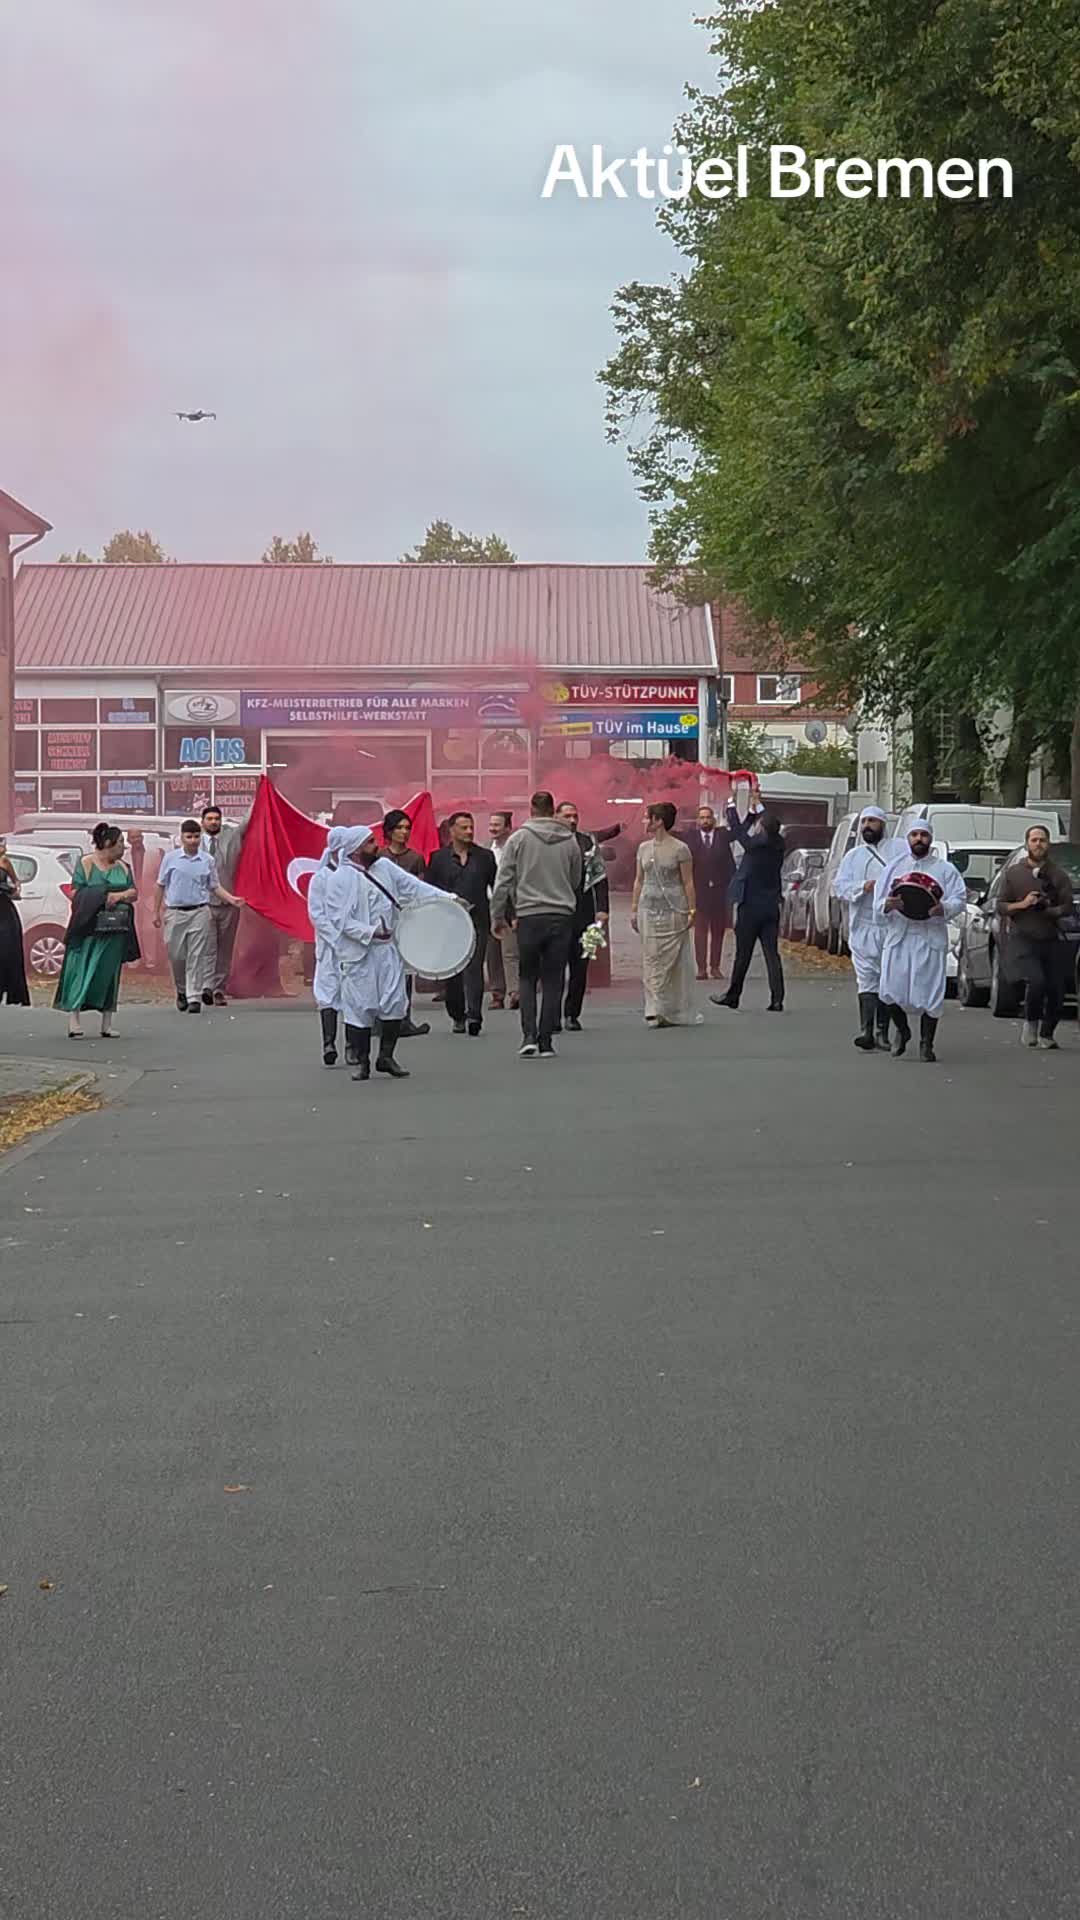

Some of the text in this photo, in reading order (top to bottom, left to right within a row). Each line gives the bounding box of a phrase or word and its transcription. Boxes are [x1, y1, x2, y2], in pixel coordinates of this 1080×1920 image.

[571, 683, 697, 699] TÜV-STÜTZPUNKT
[247, 695, 469, 709] KFZ-MEISTERBETRIEB FÜR ALLE MARKEN
[289, 711, 428, 721] SELBSTHILFE-WERKSTATT
[596, 719, 623, 734] TÜV
[626, 721, 643, 734] im
[647, 721, 690, 734] Hause
[179, 737, 246, 763] ACHS
